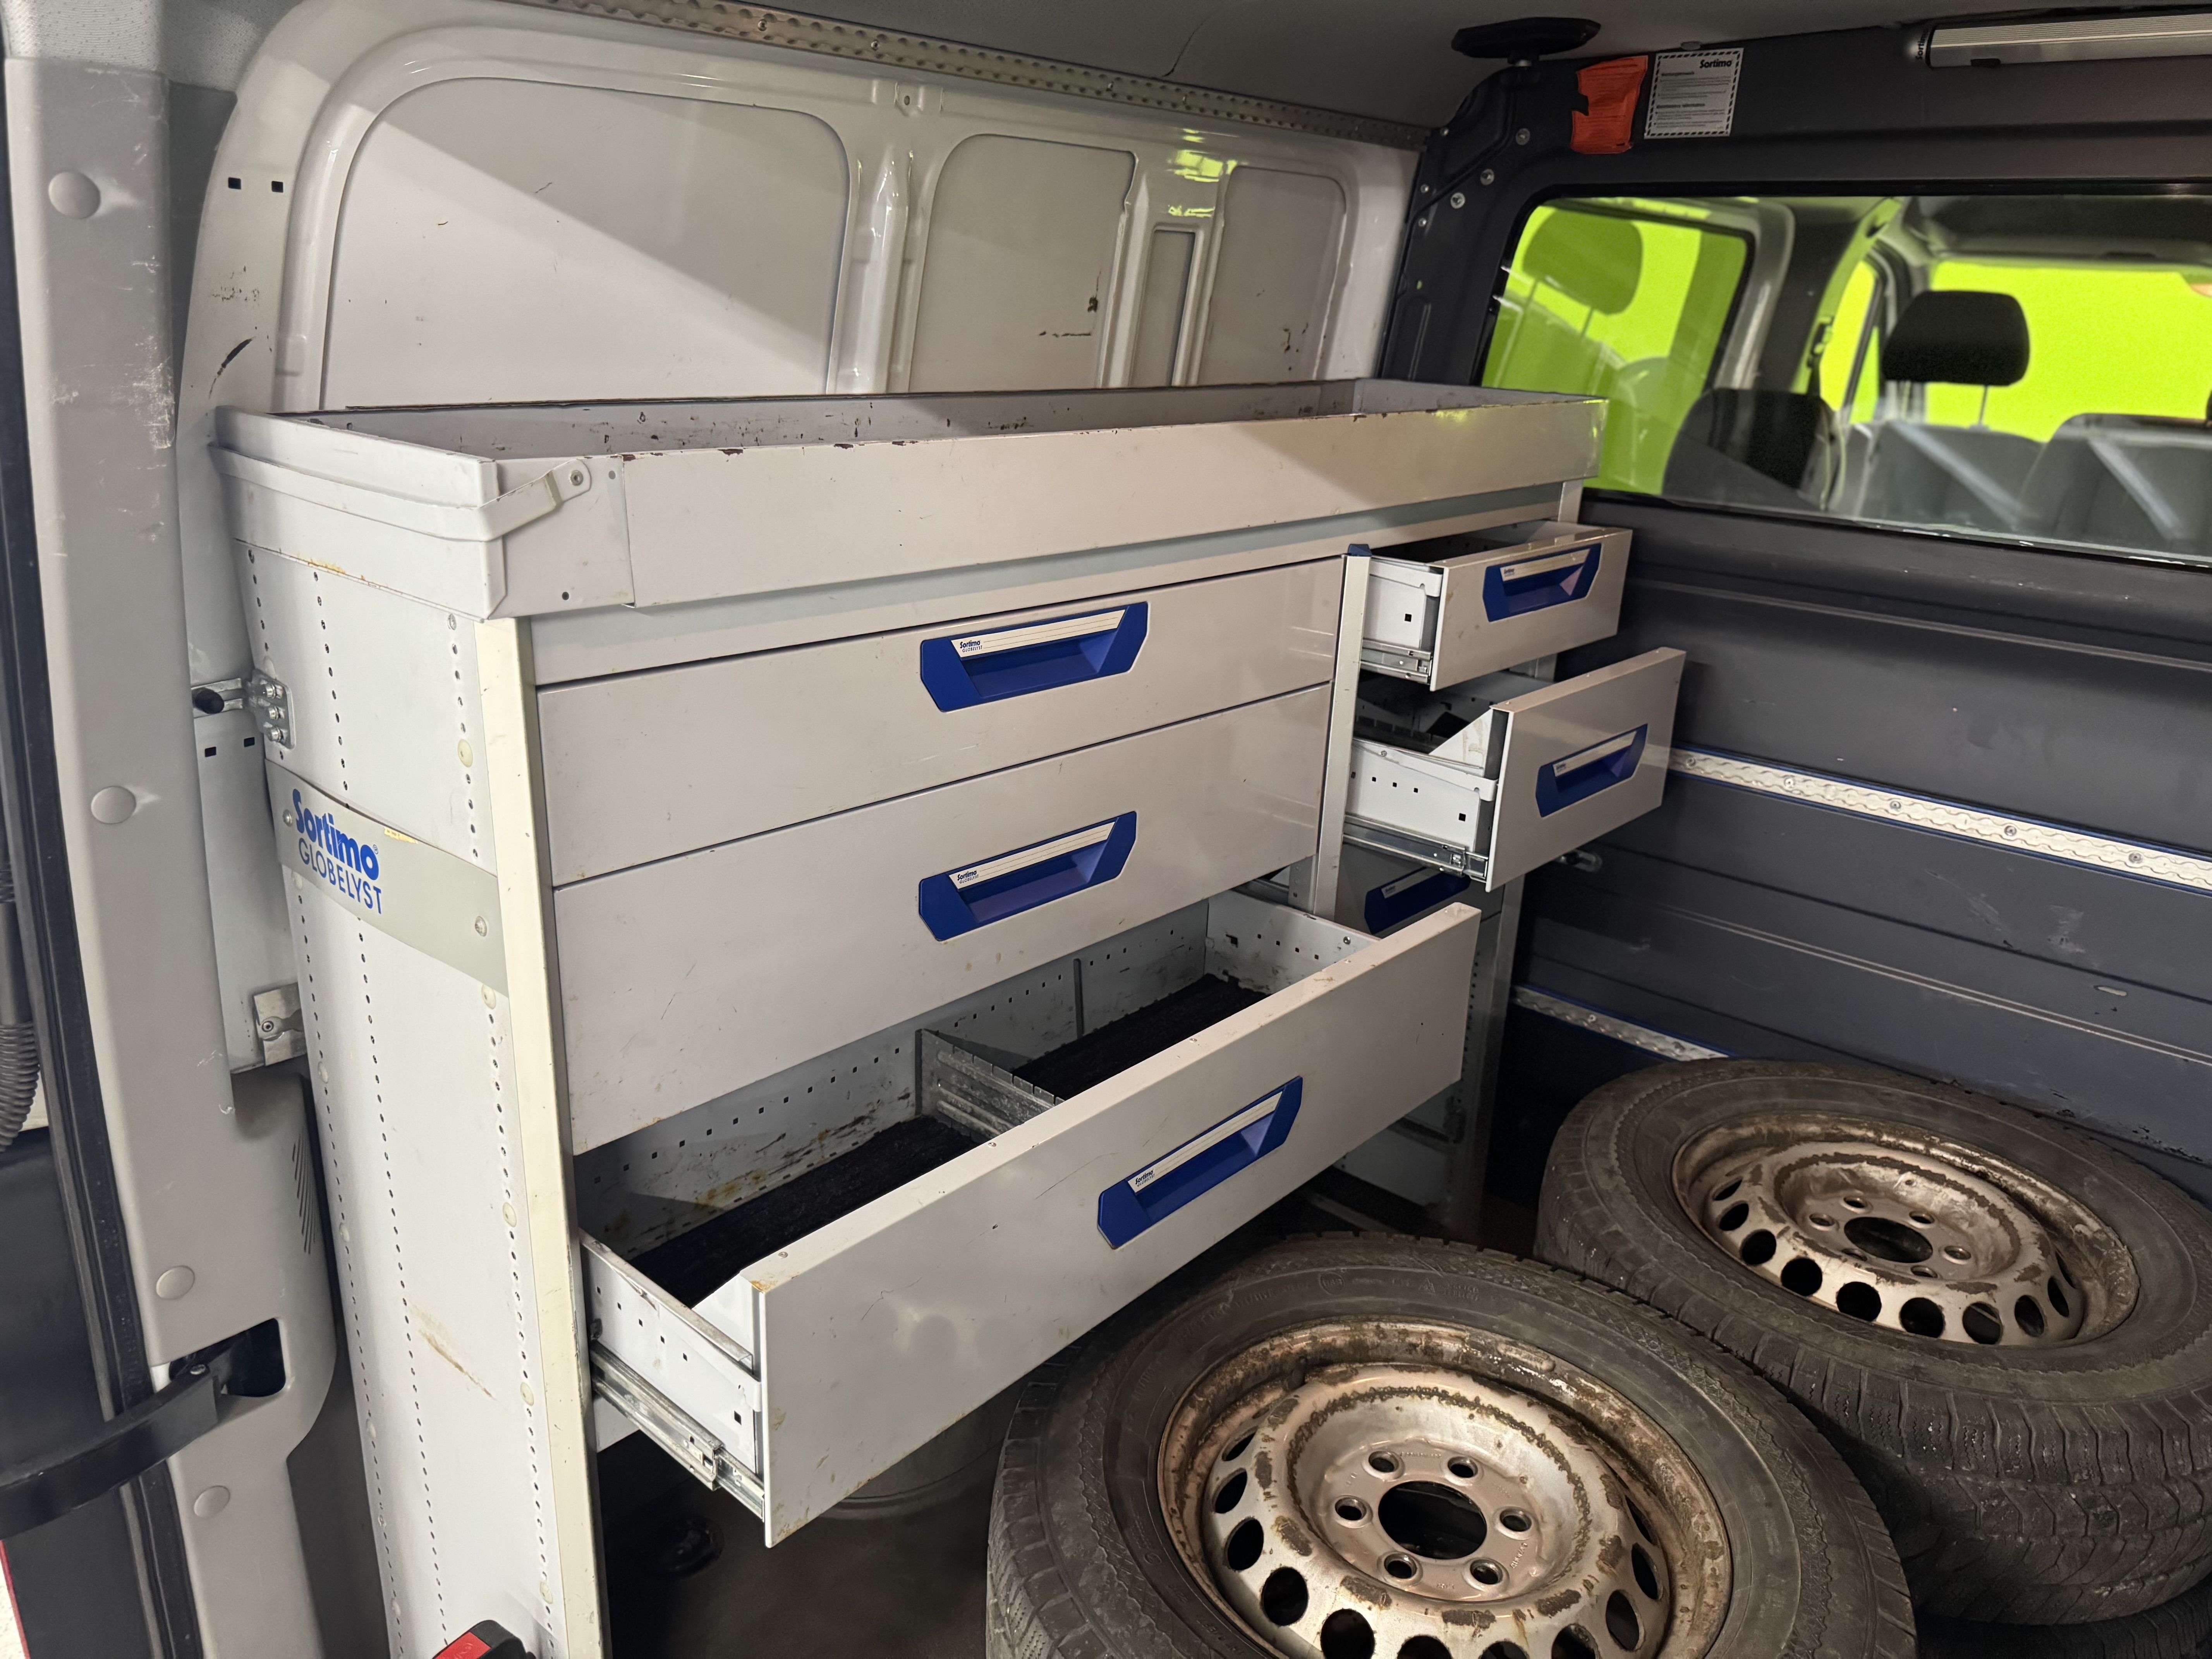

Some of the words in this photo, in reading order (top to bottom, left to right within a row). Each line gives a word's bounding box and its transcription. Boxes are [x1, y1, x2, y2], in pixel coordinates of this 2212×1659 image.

[1915, 29, 1926, 60] Sortim
[1699, 59, 1732, 69] Sortimo
[960, 640, 981, 649] Sortimo
[293, 788, 379, 881] Sortimo
[299, 838, 382, 914] GLOBELYST
[957, 871, 977, 881] Sortimo
[1135, 1170, 1154, 1185] Sortimo
